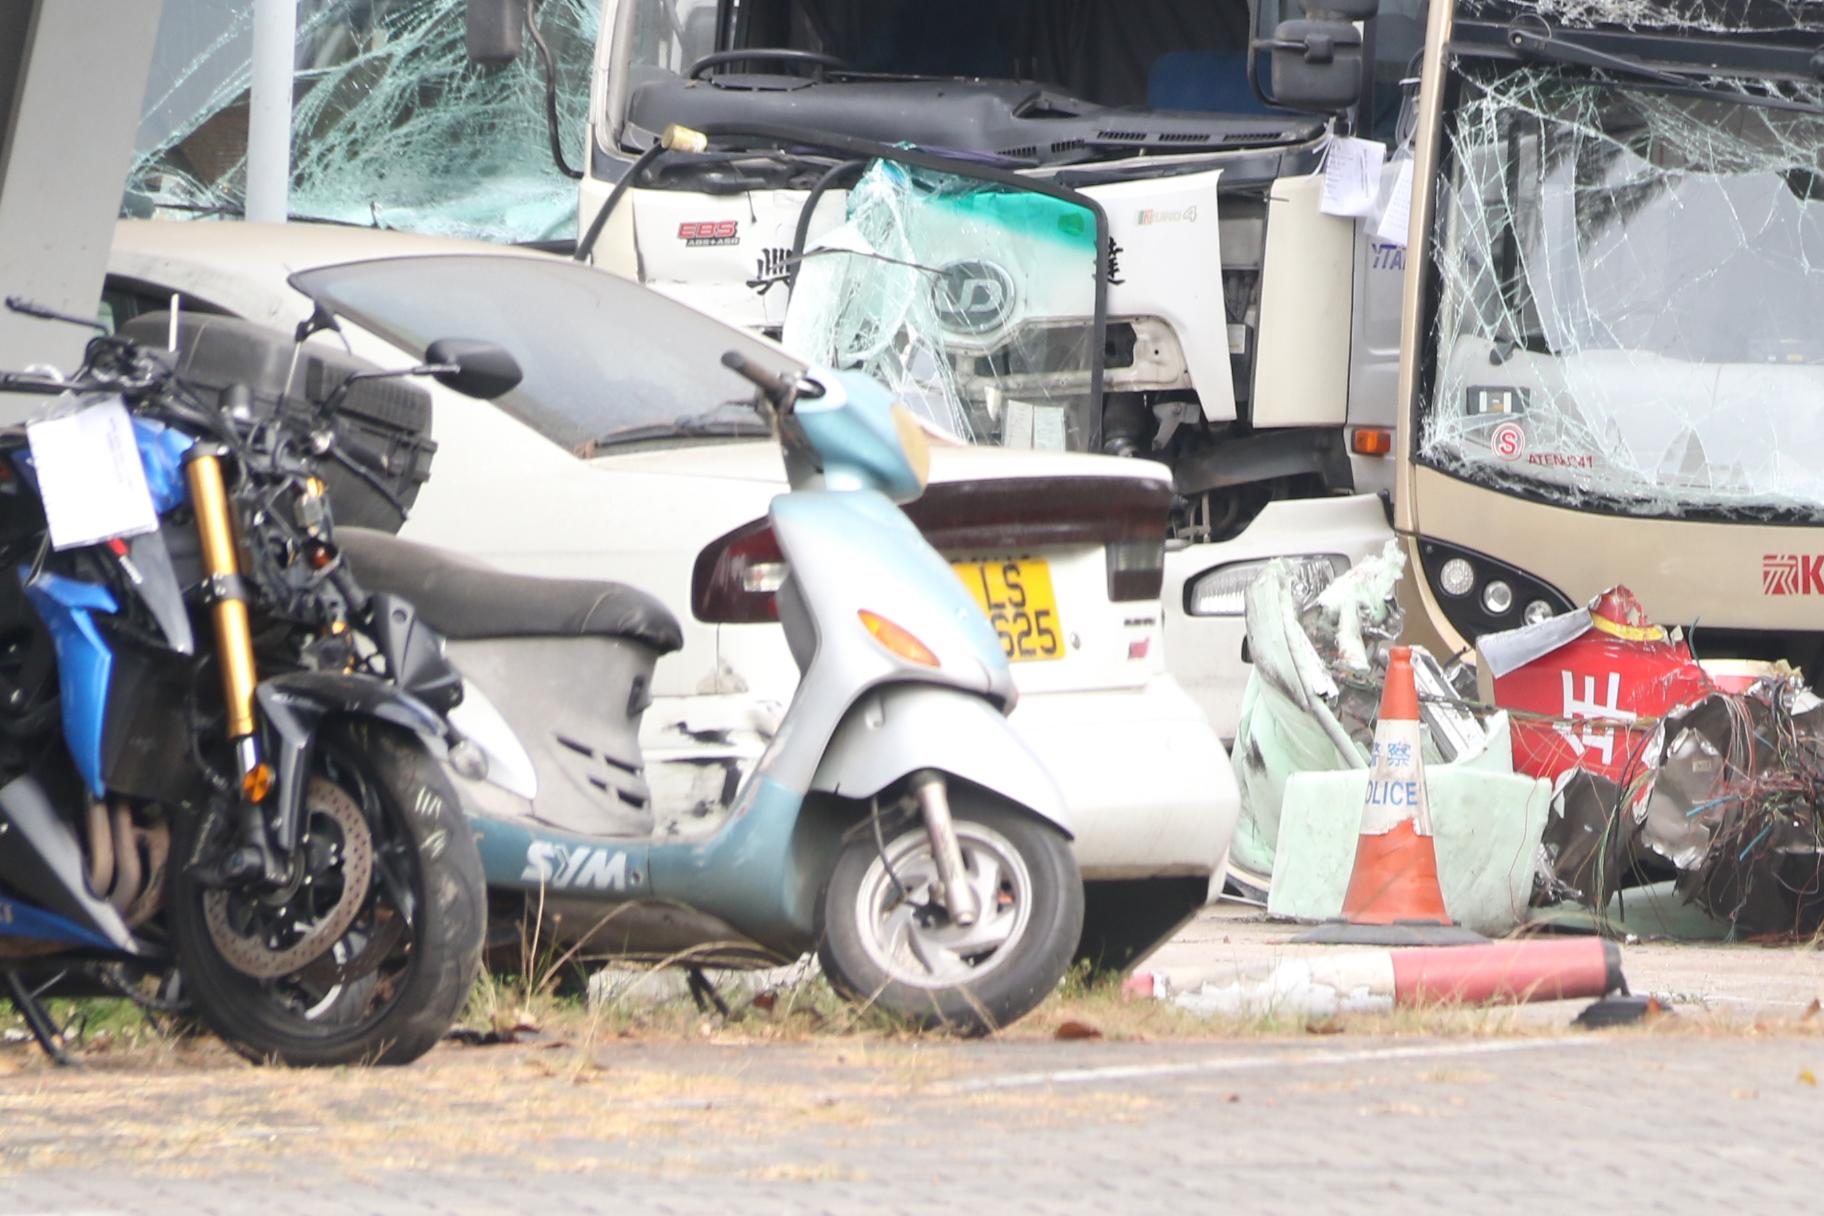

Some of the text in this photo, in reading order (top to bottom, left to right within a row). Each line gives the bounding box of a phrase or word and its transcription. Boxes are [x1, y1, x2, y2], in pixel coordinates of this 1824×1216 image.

[677, 220, 738, 239] EBS
[1371, 243, 1407, 271] YTA
[979, 563, 1026, 610] LS
[991, 610, 1058, 659] 625
[520, 840, 628, 892] SYM
